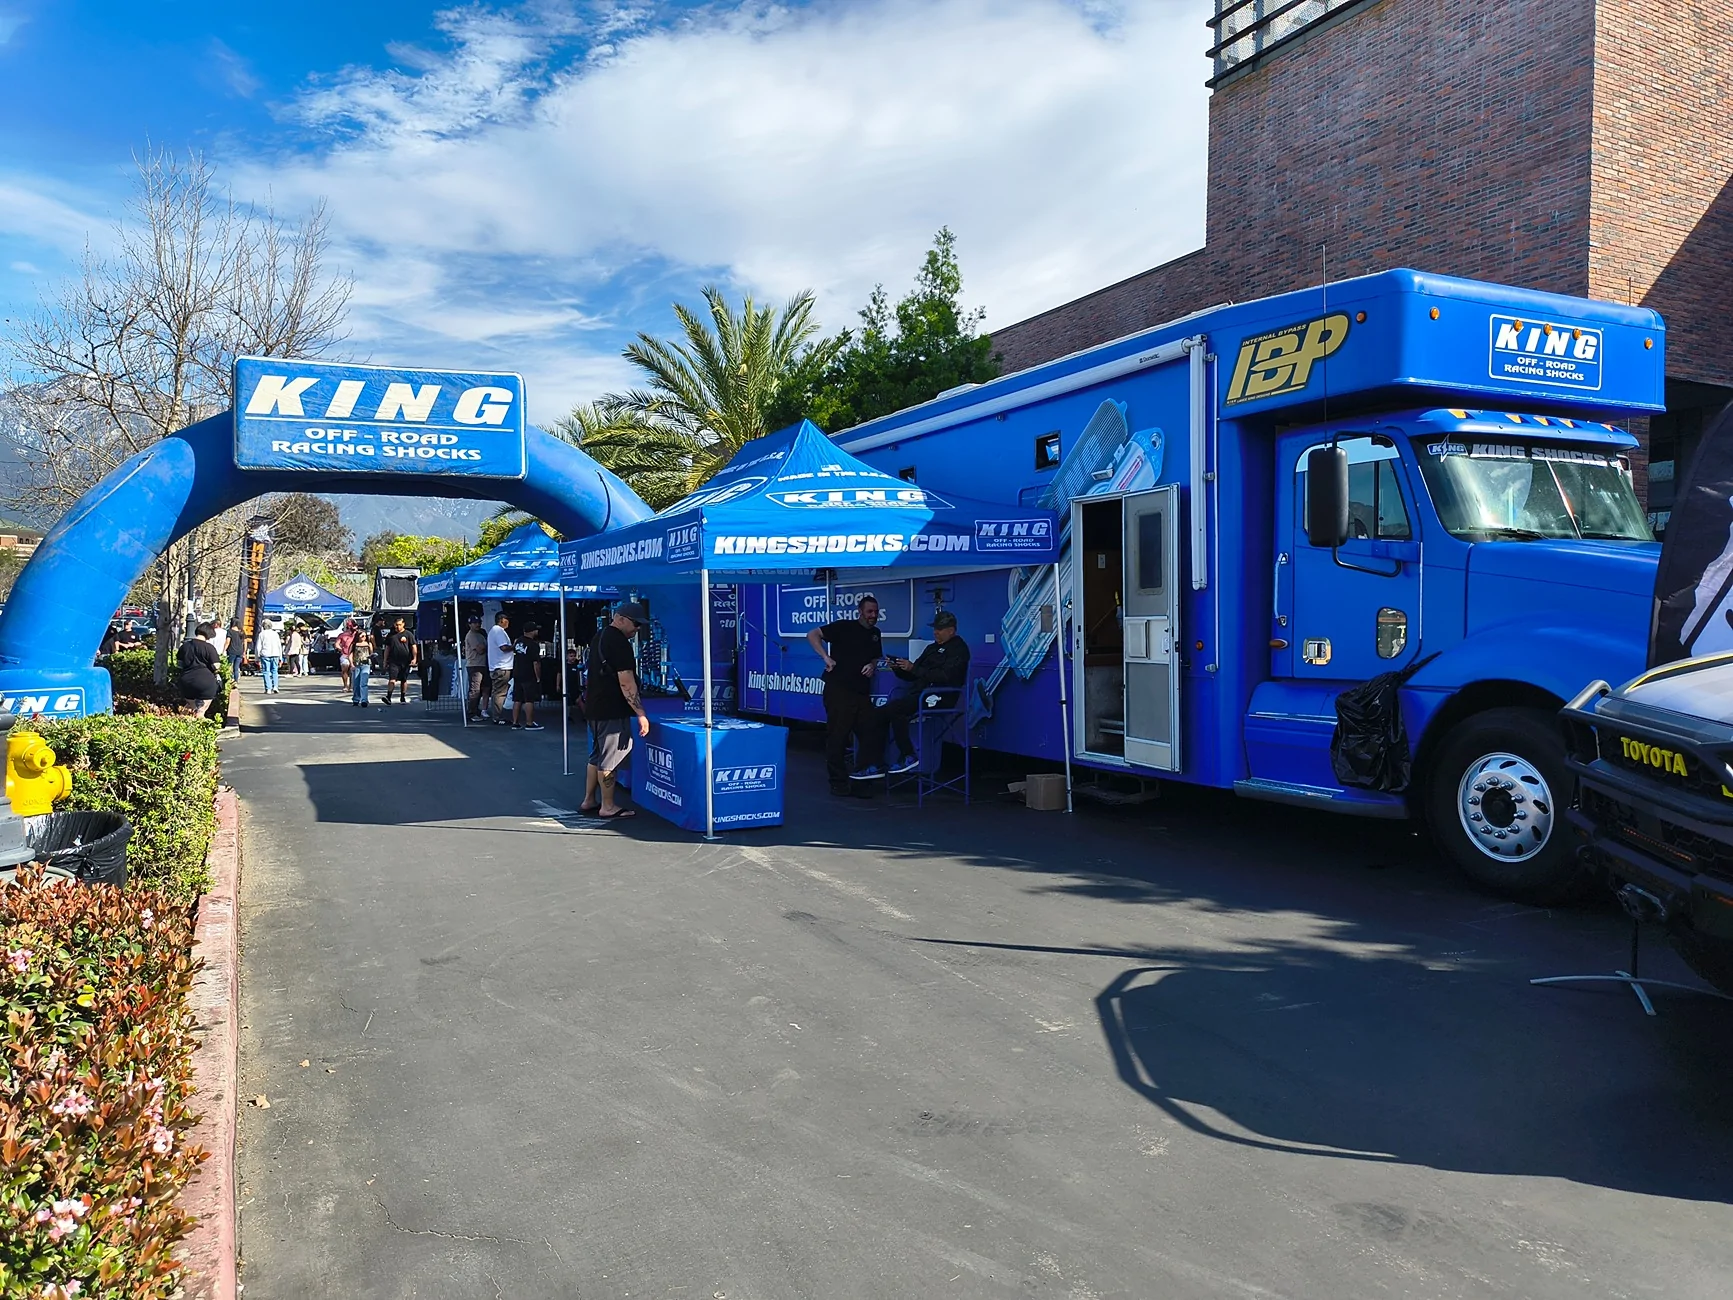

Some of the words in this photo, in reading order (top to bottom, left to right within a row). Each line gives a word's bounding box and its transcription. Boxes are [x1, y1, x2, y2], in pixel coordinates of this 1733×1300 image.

[1242, 332, 1277, 347] INTERNAL
[1278, 324, 1307, 337] BYPASS
[1495, 323, 1598, 360] KING
[1504, 364, 1544, 376] RACING
[1545, 369, 1585, 381] SHOCKS
[1517, 356, 1538, 366] OFF
[1545, 360, 1576, 371] ROAD
[245, 374, 514, 425] KING
[304, 427, 358, 441] OFF
[381, 431, 459, 445] ROAD
[271, 440, 375, 456] RACING
[382, 446, 482, 460] SHOCKS
[1471, 443, 1526, 458] KING
[1531, 448, 1607, 466] SHOCKS
[784, 490, 928, 503] KING
[979, 522, 1049, 536] KING
[580, 536, 664, 570] KINGSHOCKS.COM
[713, 533, 970, 555] KINGSHOCKS.COM
[804, 595, 827, 608] OFF
[836, 608, 887, 621] SHOS
[3, 694, 81, 713] ING
[648, 747, 673, 769] KING
[1620, 736, 1689, 777] TOYOTA
[715, 767, 774, 782] KING
[713, 811, 781, 823] KINGSHOCKS.COM
